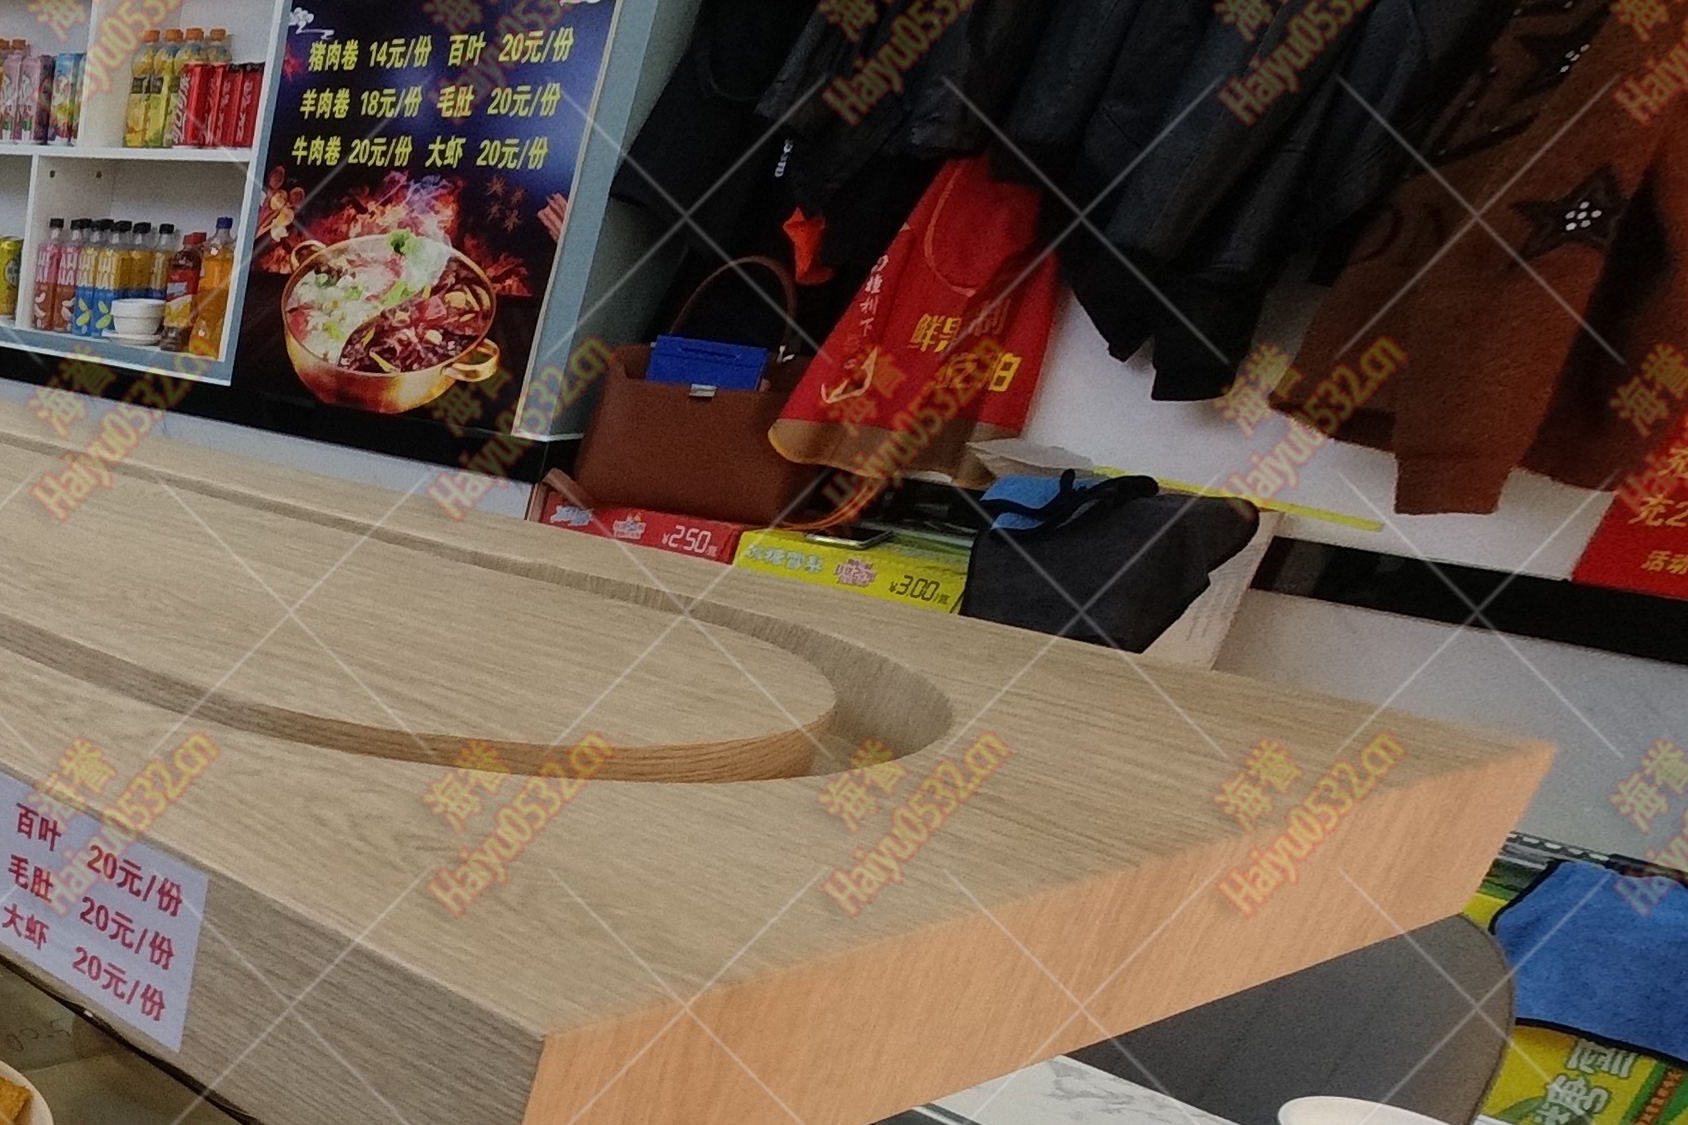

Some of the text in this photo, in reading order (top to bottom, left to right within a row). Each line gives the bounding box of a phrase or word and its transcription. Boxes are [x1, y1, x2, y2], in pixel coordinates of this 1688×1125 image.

[309, 27, 574, 71] 猪肉卷 14元/份 百叶 20元/份
[300, 89, 350, 119] 羊肉卷
[361, 86, 423, 118] 18元/份
[437, 85, 474, 118] 毛肚
[488, 83, 561, 117] 20元/份
[291, 136, 548, 170] 牛肉卷 20元/份 大虾 20元/份
[16, 802, 62, 851] 百叶
[87, 844, 183, 917] 20元/份
[8, 854, 54, 904] 毛肚
[80, 897, 175, 971] 20元/份
[2, 903, 50, 950] 大虾
[72, 947, 165, 1022] 20元/份
